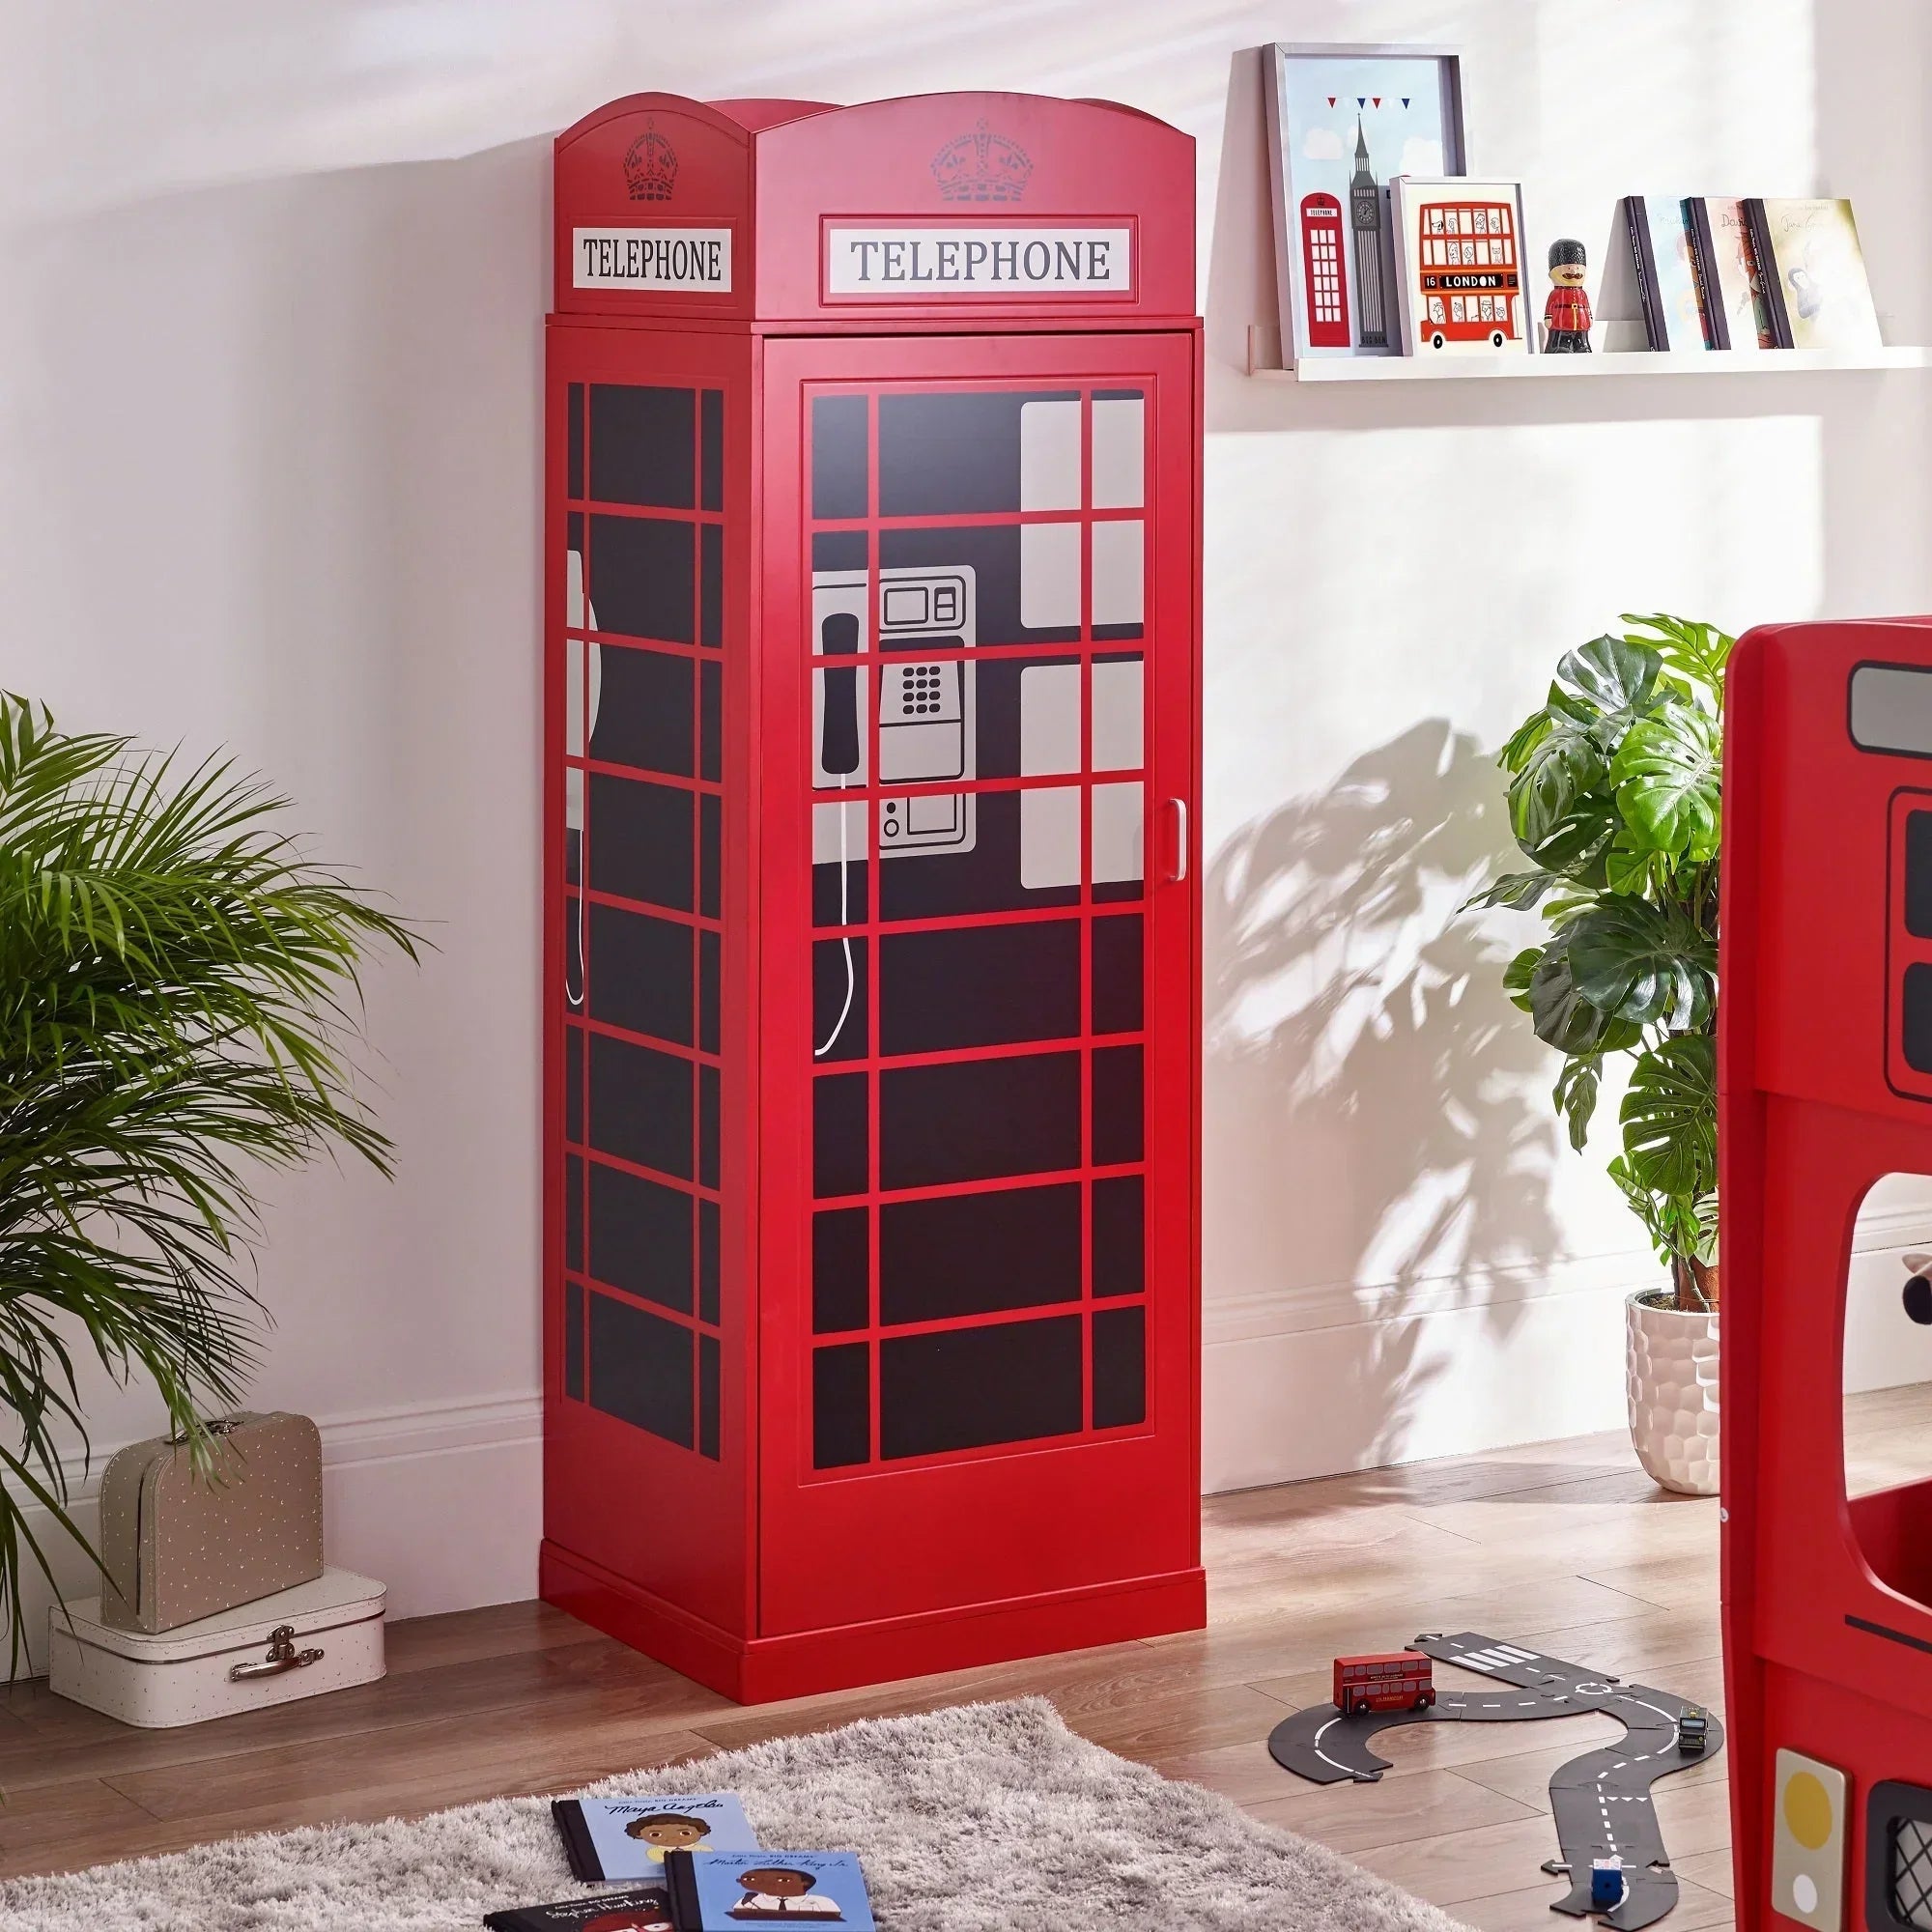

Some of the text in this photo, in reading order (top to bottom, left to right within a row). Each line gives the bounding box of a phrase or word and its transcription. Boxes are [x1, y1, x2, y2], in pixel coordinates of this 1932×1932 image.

[582, 239, 722, 281] TELEPHONE
[850, 241, 1111, 281] TELEPHONE
[1426, 276, 1436, 287] 16
[1445, 275, 1496, 288] LONDON
[604, 1799, 724, 1816] Maya Angelou
